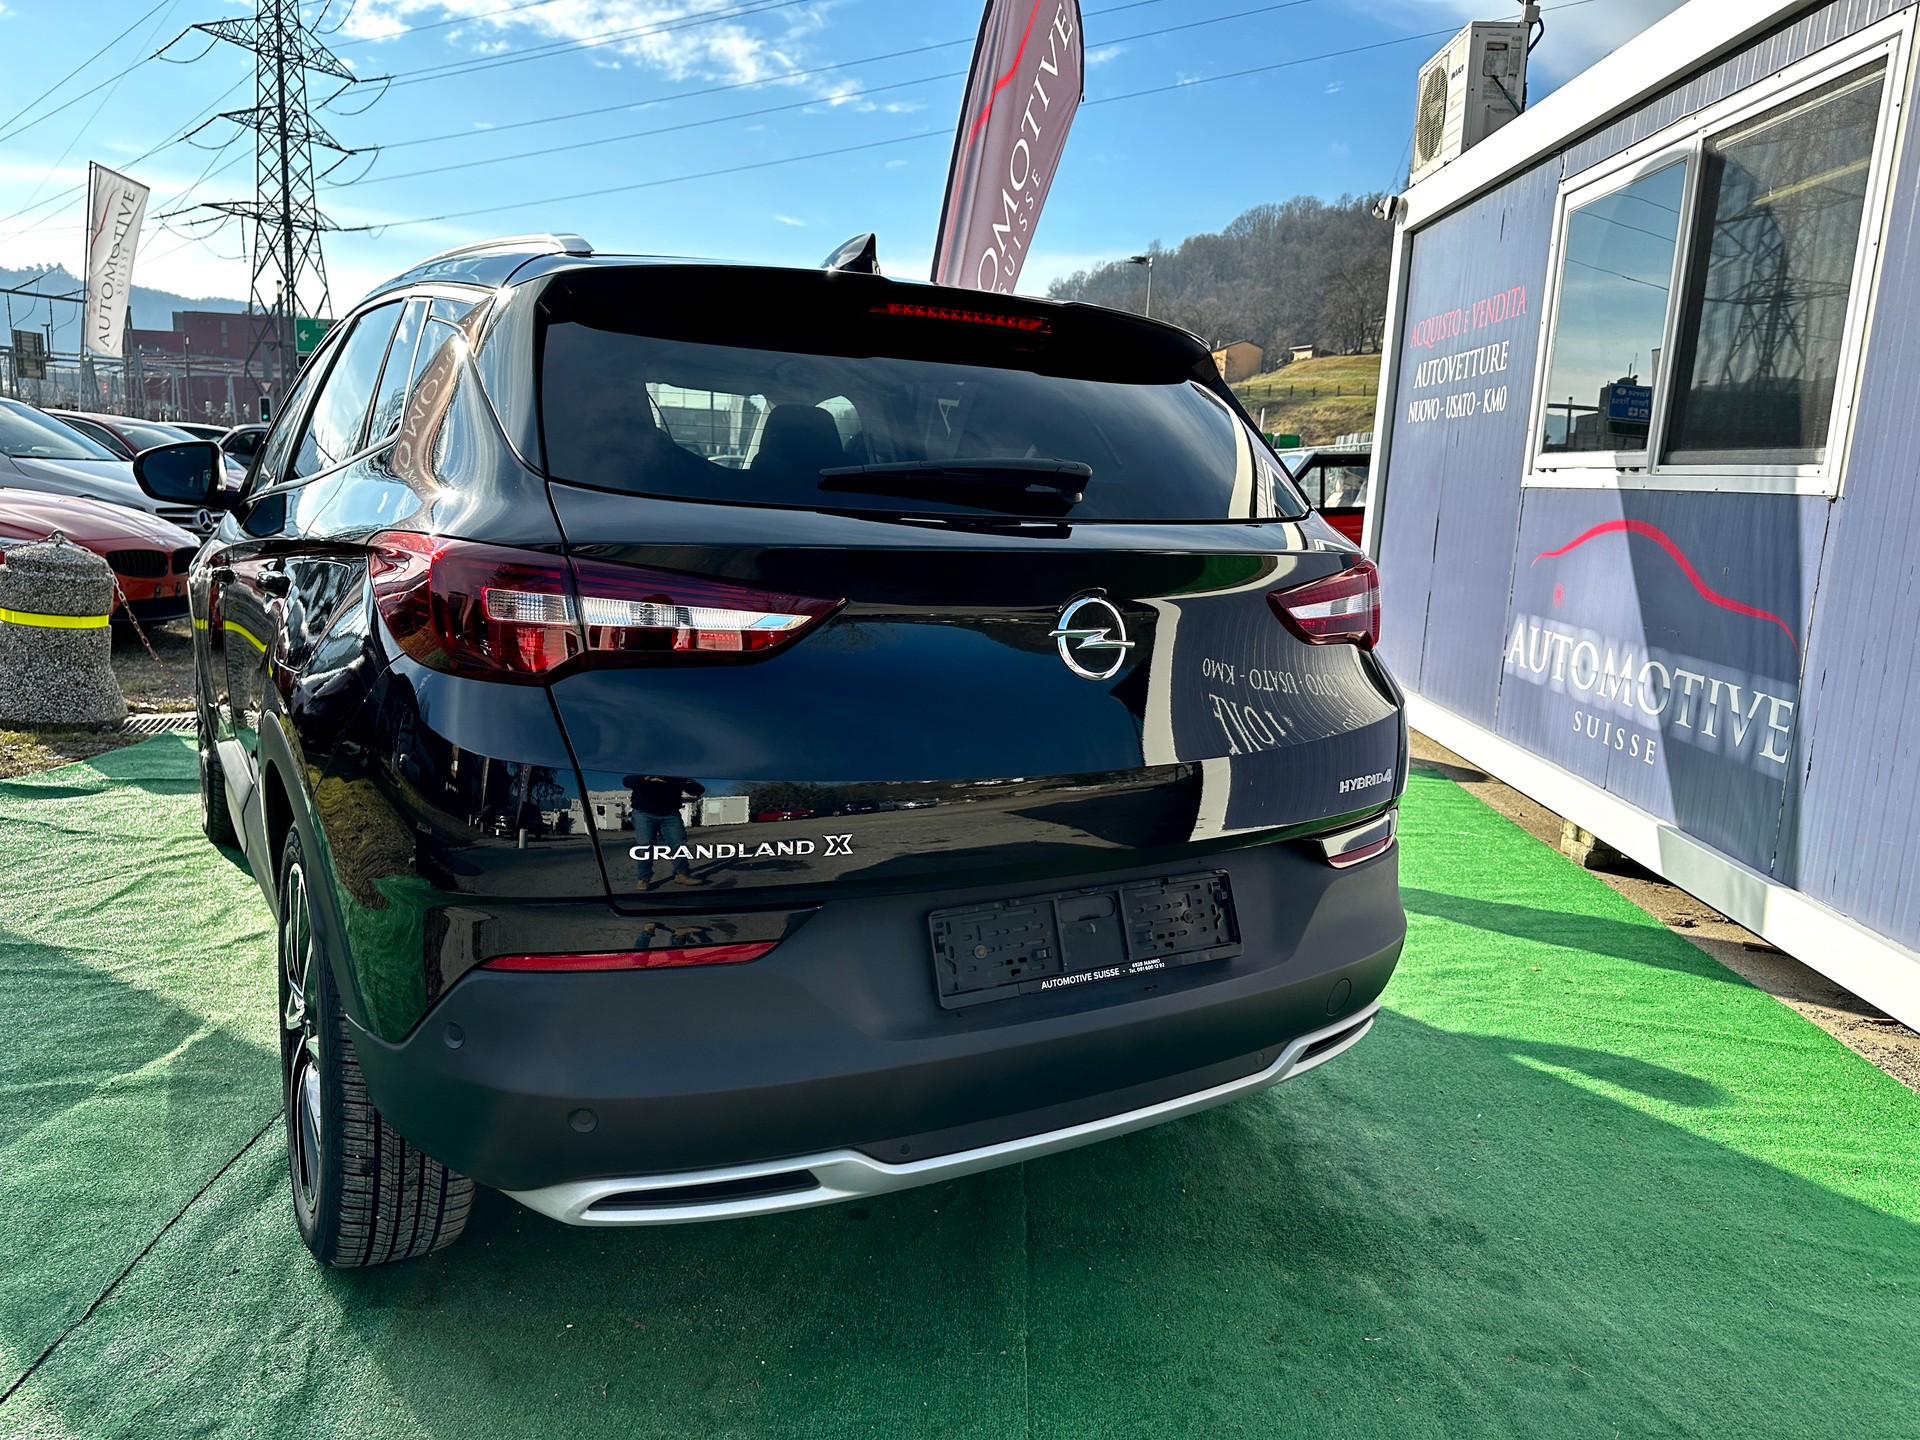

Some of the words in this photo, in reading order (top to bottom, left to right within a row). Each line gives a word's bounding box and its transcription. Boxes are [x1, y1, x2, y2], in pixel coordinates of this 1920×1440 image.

[978, 3, 1073, 293] OMOTIVE
[98, 190, 136, 348] AUTOMOTIVE
[1410, 308, 1462, 349] ACQUISTO
[1472, 286, 1526, 330] VENDITA
[1414, 340, 1510, 389] AUTOVETTURE
[1407, 397, 1440, 423] NUOVO
[1445, 391, 1476, 419] USATO
[1506, 622, 1794, 764] AUTOMOTIVE
[1573, 710, 1656, 765] SUISSE
[1339, 768, 1392, 794] HYBRID4
[629, 839, 816, 861] GRANDLAND
[822, 833, 854, 857] X
[1041, 972, 1093, 990] AUTOMOTIVE
[1093, 967, 1120, 981] SUISSE
